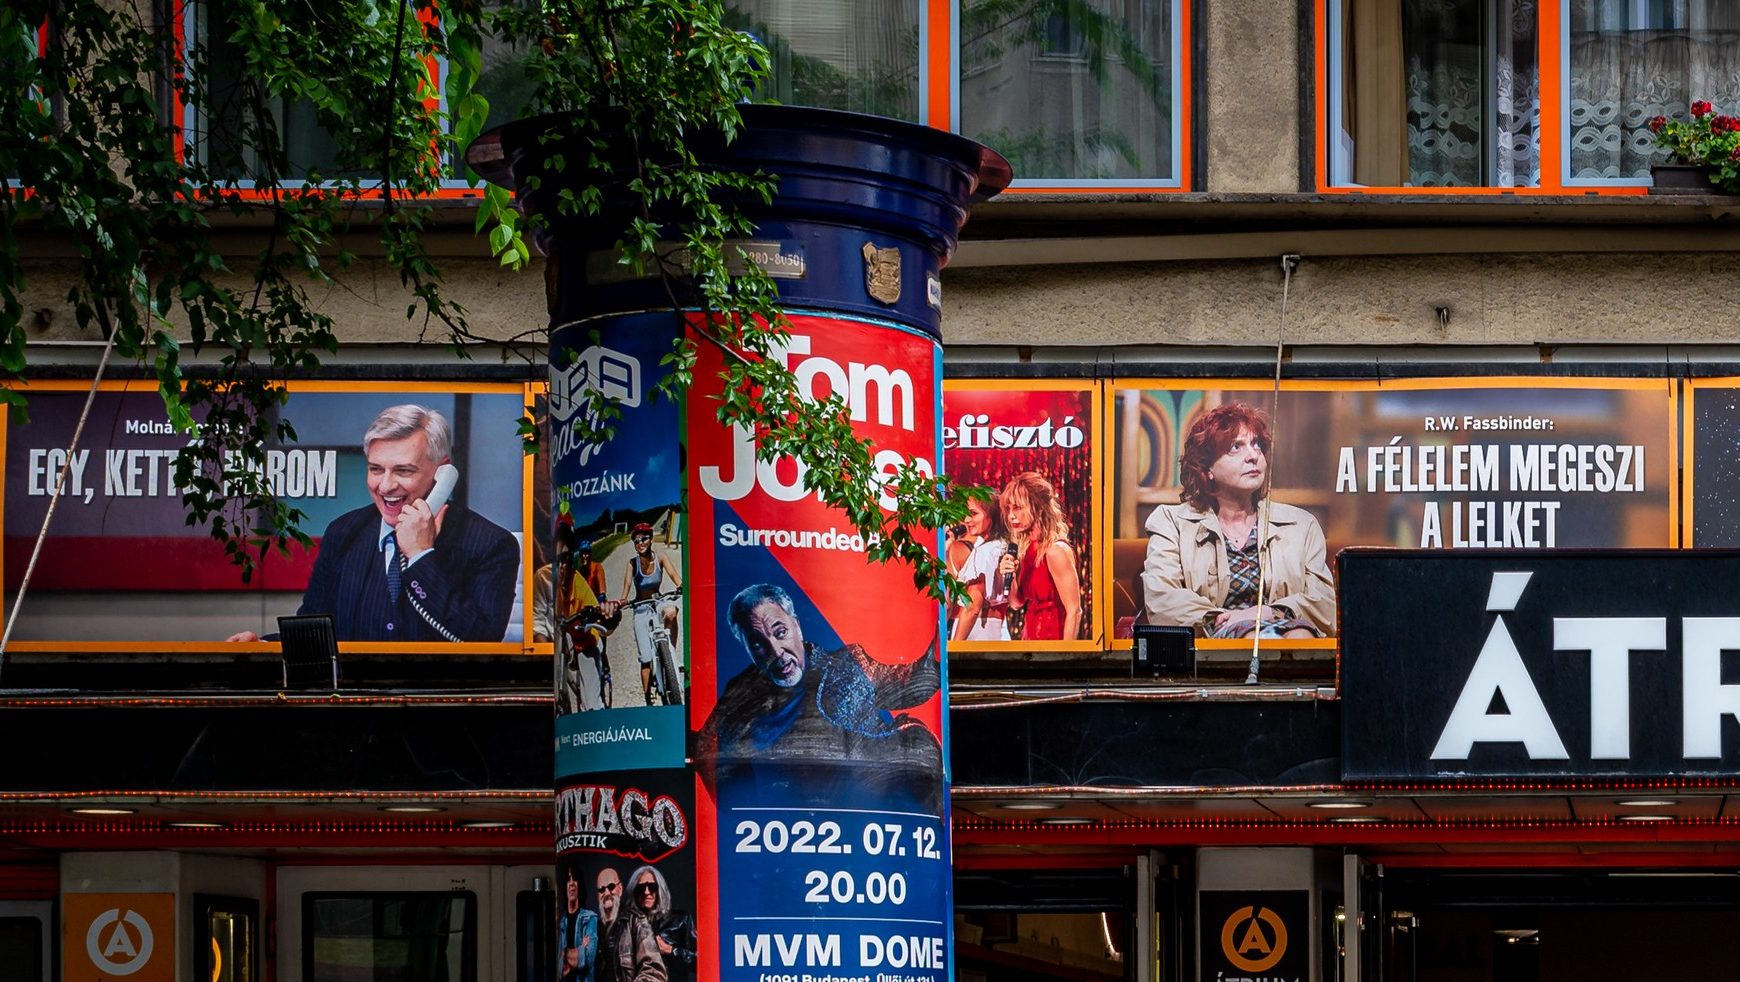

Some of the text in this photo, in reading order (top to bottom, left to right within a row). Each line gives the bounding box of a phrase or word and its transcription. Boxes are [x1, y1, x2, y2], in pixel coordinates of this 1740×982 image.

[743, 333, 914, 431] Tom
[1425, 416, 1554, 431] R.W. Fassbinder:
[28, 448, 94, 505] EGY,
[1336, 436, 1645, 493] A FÉLELEM MEGESZI
[719, 523, 865, 553] Surrounded
[1421, 501, 1561, 548] A LELKET
[572, 725, 653, 747] ENERGIÁJÁVAL
[735, 819, 942, 861] 2022. 07. 12.
[804, 870, 907, 905] 20.00
[734, 933, 944, 970] MVM DOME
